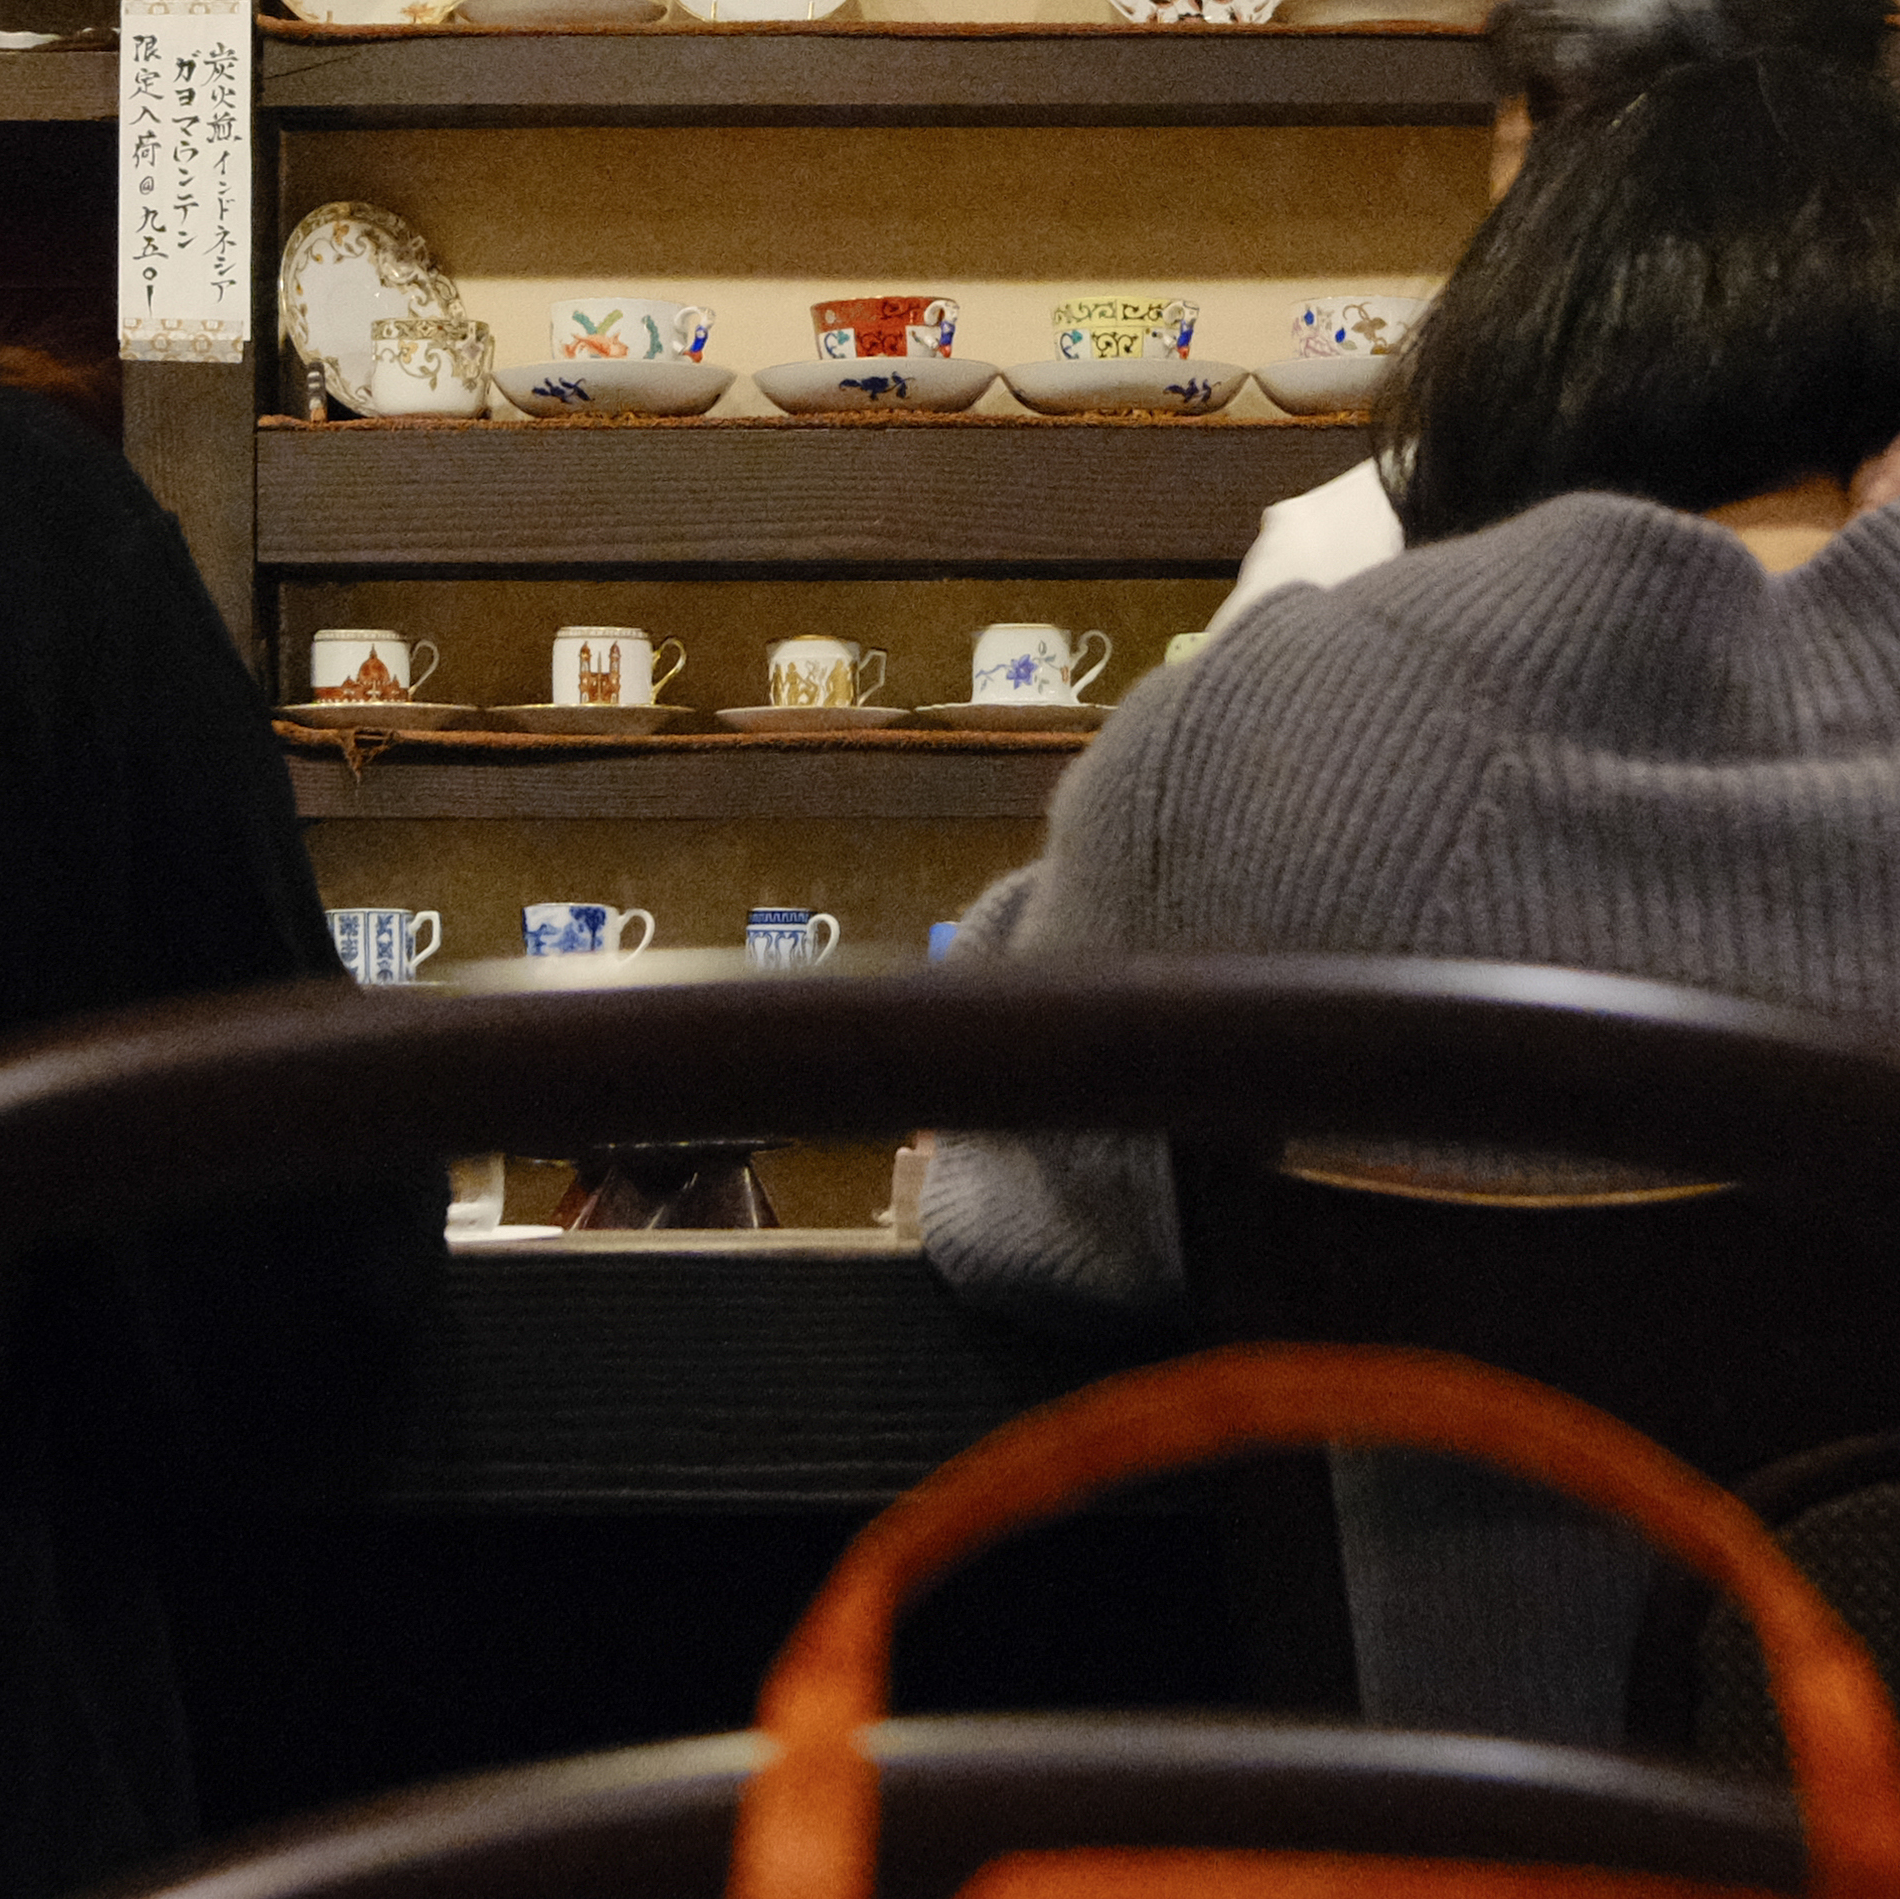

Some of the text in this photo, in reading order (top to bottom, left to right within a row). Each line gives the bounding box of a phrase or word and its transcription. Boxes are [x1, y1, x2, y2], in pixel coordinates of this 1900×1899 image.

[171, 49, 202, 250] ガヨマウンテン
[201, 41, 243, 304] 炭火煎インドネシア
